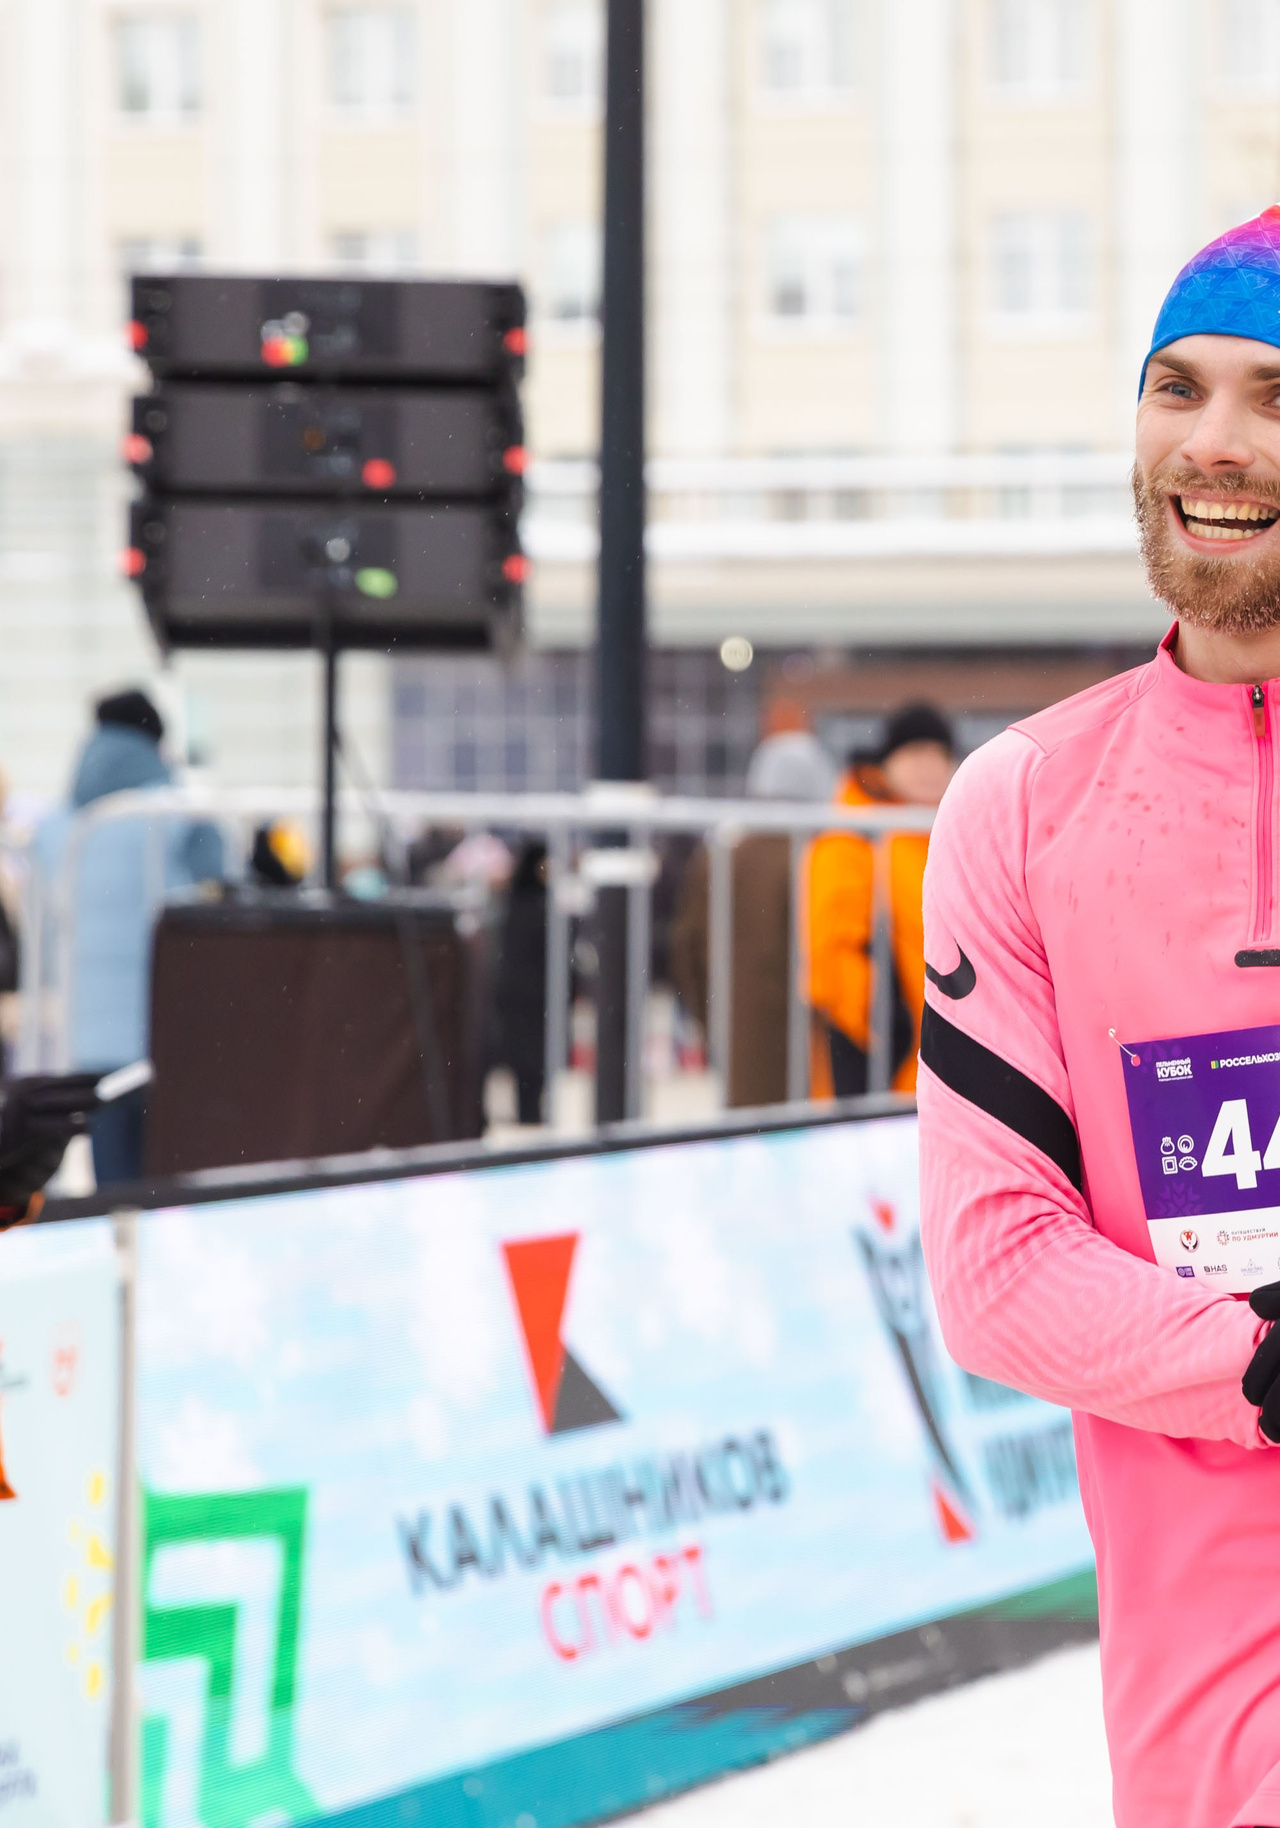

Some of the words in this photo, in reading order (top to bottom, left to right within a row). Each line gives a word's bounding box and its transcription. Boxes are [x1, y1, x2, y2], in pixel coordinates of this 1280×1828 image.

[1157, 1065, 1193, 1079] КУБОК
[1243, 1232, 1279, 1242] УДМУРТИИ
[1210, 1263, 1228, 1273] HAS
[395, 1428, 790, 1596] КАЛАШНИКОВ
[542, 1541, 714, 1662] СПОРТ
